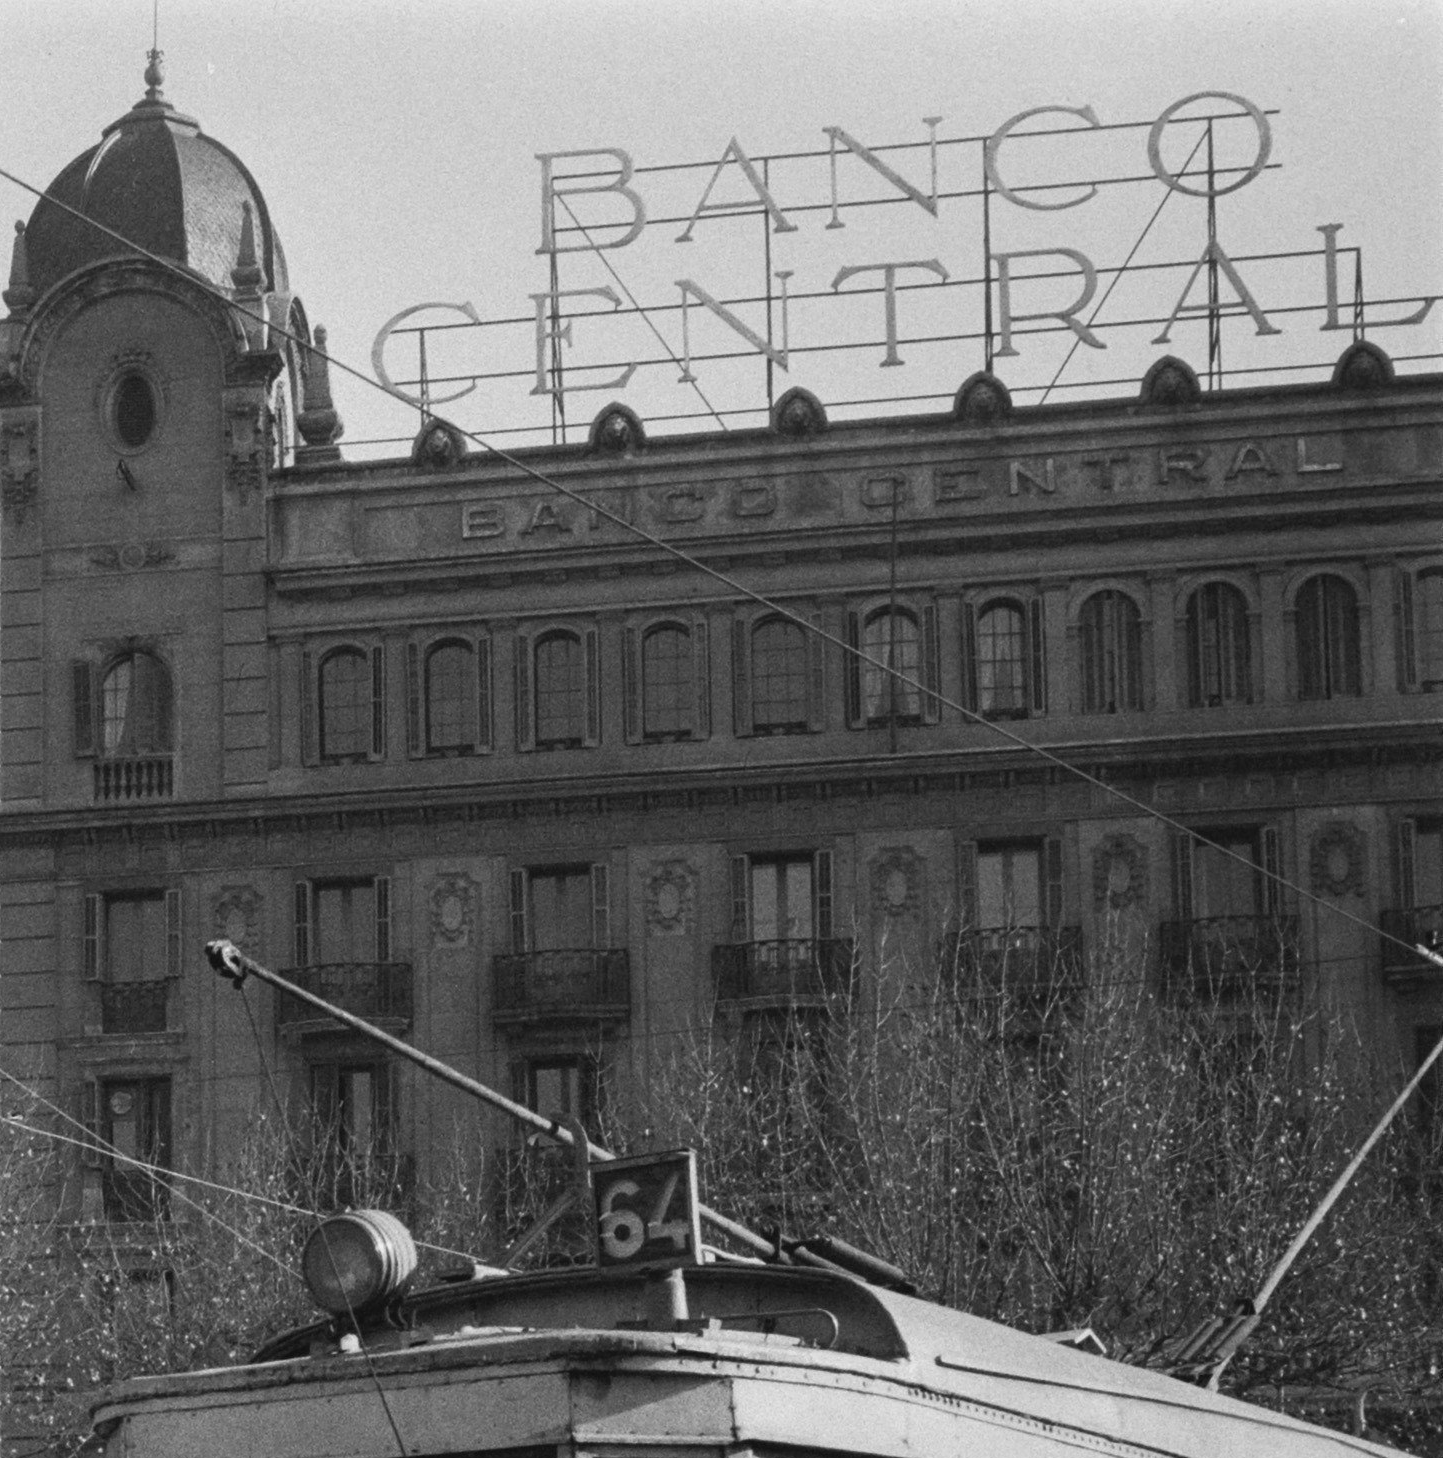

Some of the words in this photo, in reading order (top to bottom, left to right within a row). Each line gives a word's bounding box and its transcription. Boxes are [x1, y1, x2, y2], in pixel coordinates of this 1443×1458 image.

[534, 90, 1273, 254] BANCO
[371, 223, 1438, 404] CENTRAL
[461, 480, 776, 540] BANCO
[865, 438, 1344, 509] CENTRAL
[599, 1171, 690, 1258] 64
